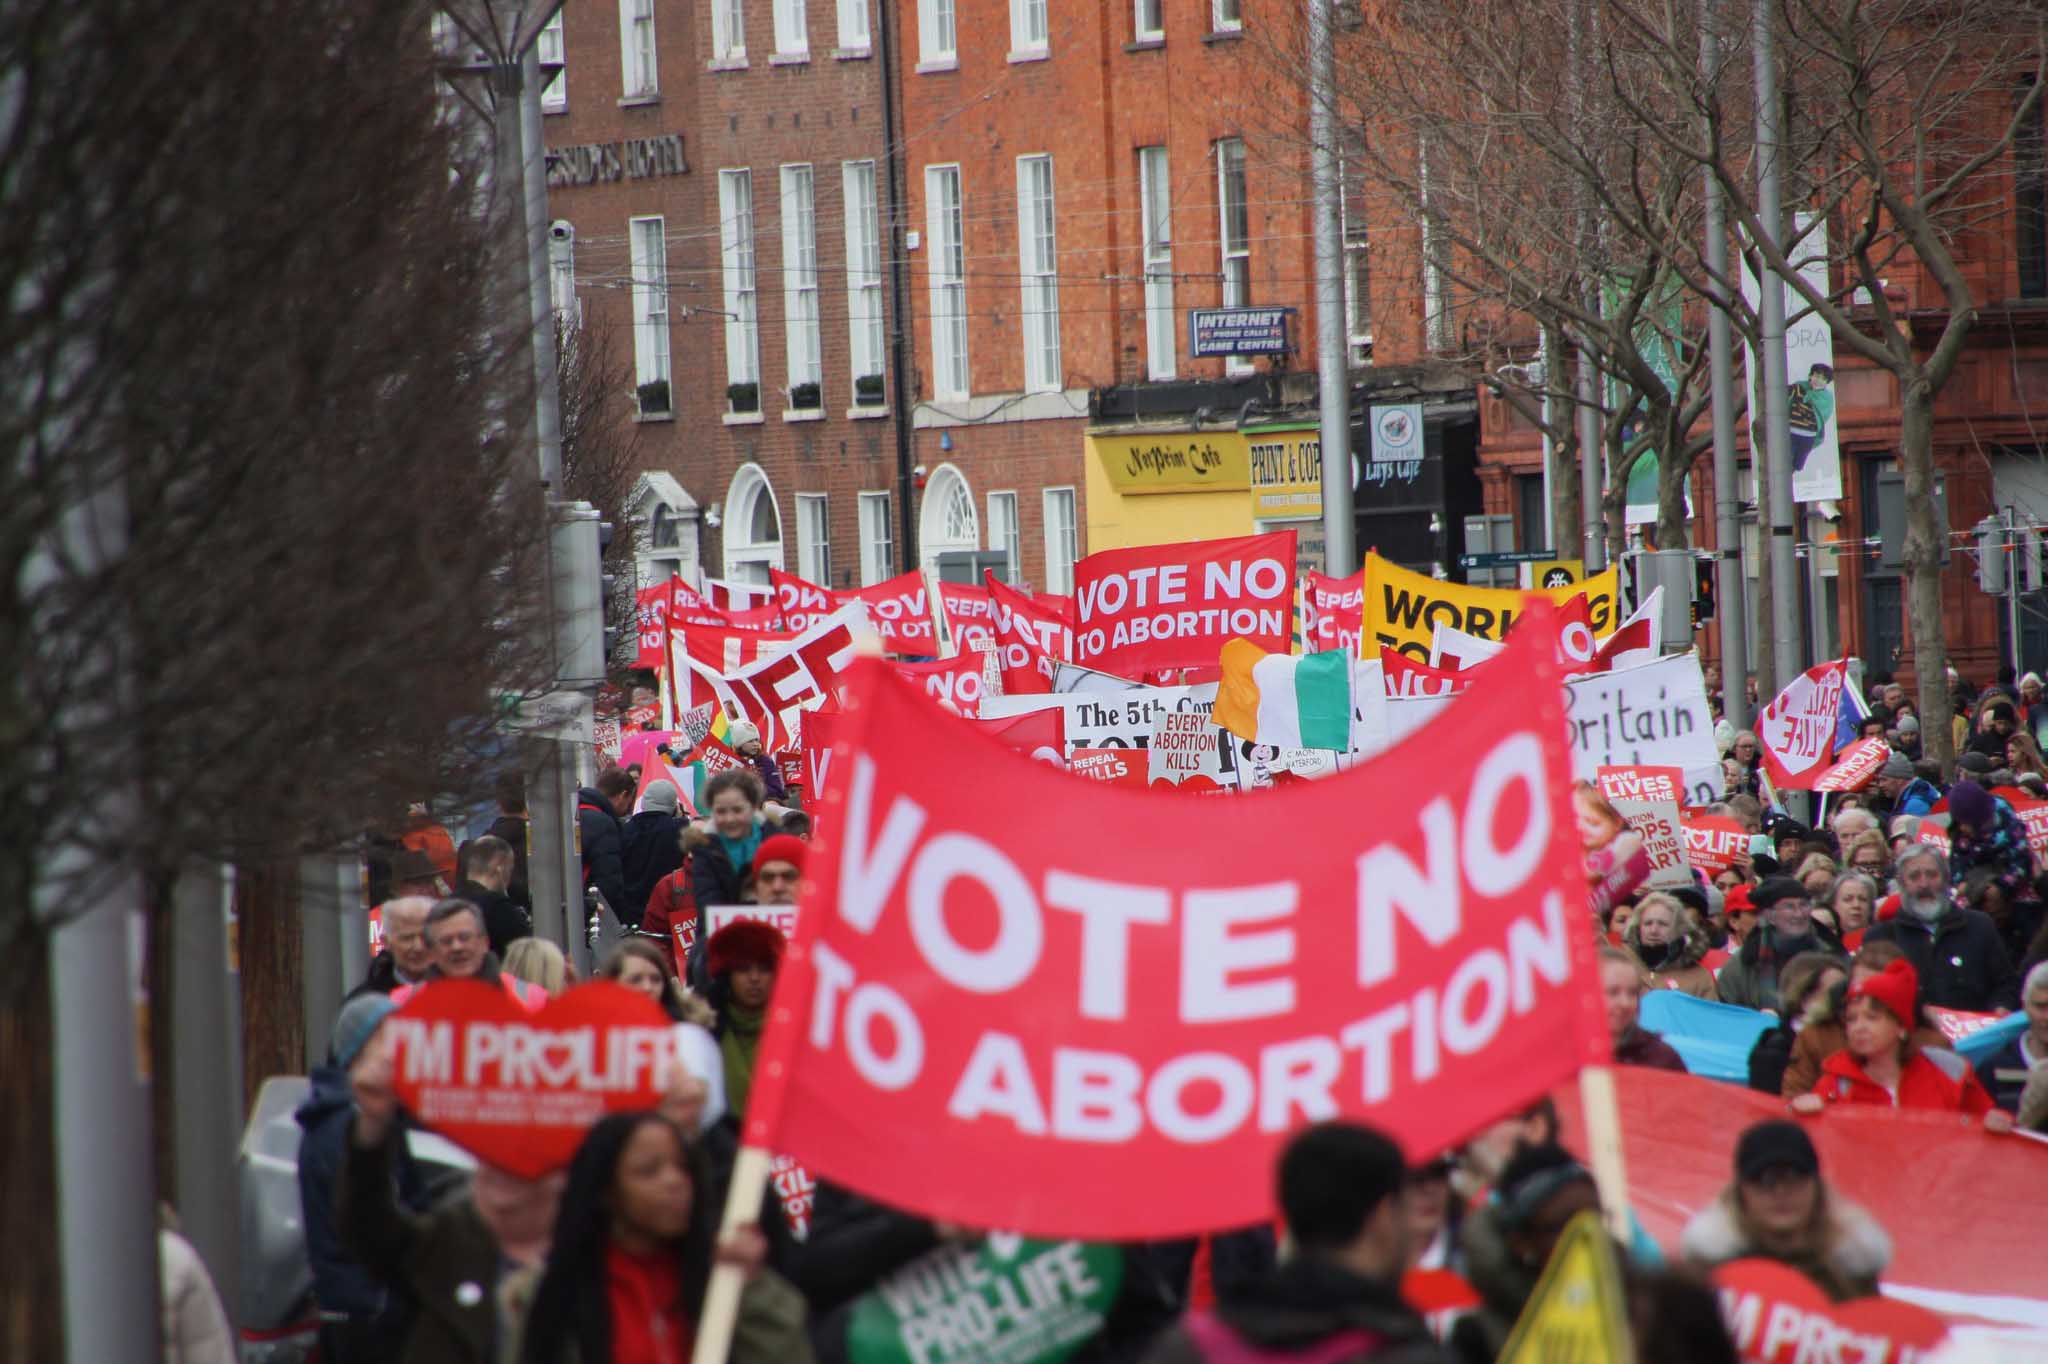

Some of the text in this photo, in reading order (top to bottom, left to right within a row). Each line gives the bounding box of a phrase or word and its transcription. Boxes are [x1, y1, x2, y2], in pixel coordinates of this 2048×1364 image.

[1198, 312, 1282, 328] INTERNET
[1251, 443, 1285, 486] PRINT
[1077, 558, 1287, 623] VOTE NO
[1315, 588, 1364, 609] EPEA
[1077, 628, 1106, 661] TO
[1111, 608, 1283, 649] ABORTION
[682, 708, 706, 726] LOVE
[1077, 701, 1120, 728] The
[1166, 714, 1208, 731] EVERY
[1154, 733, 1216, 752] ABORTION
[1073, 753, 1118, 770] REPEAL
[1166, 753, 1200, 770] KILLS
[1285, 758, 1322, 769] WATERFORD
[1601, 770, 1637, 783] SAVE
[1604, 775, 1673, 798] LIVES
[1646, 838, 1678, 853] TING
[837, 731, 1553, 1024] VOTE NO
[674, 917, 698, 934] SAV
[811, 893, 1572, 1144] TO ABORTION
[384, 1018, 454, 1085] I'M
